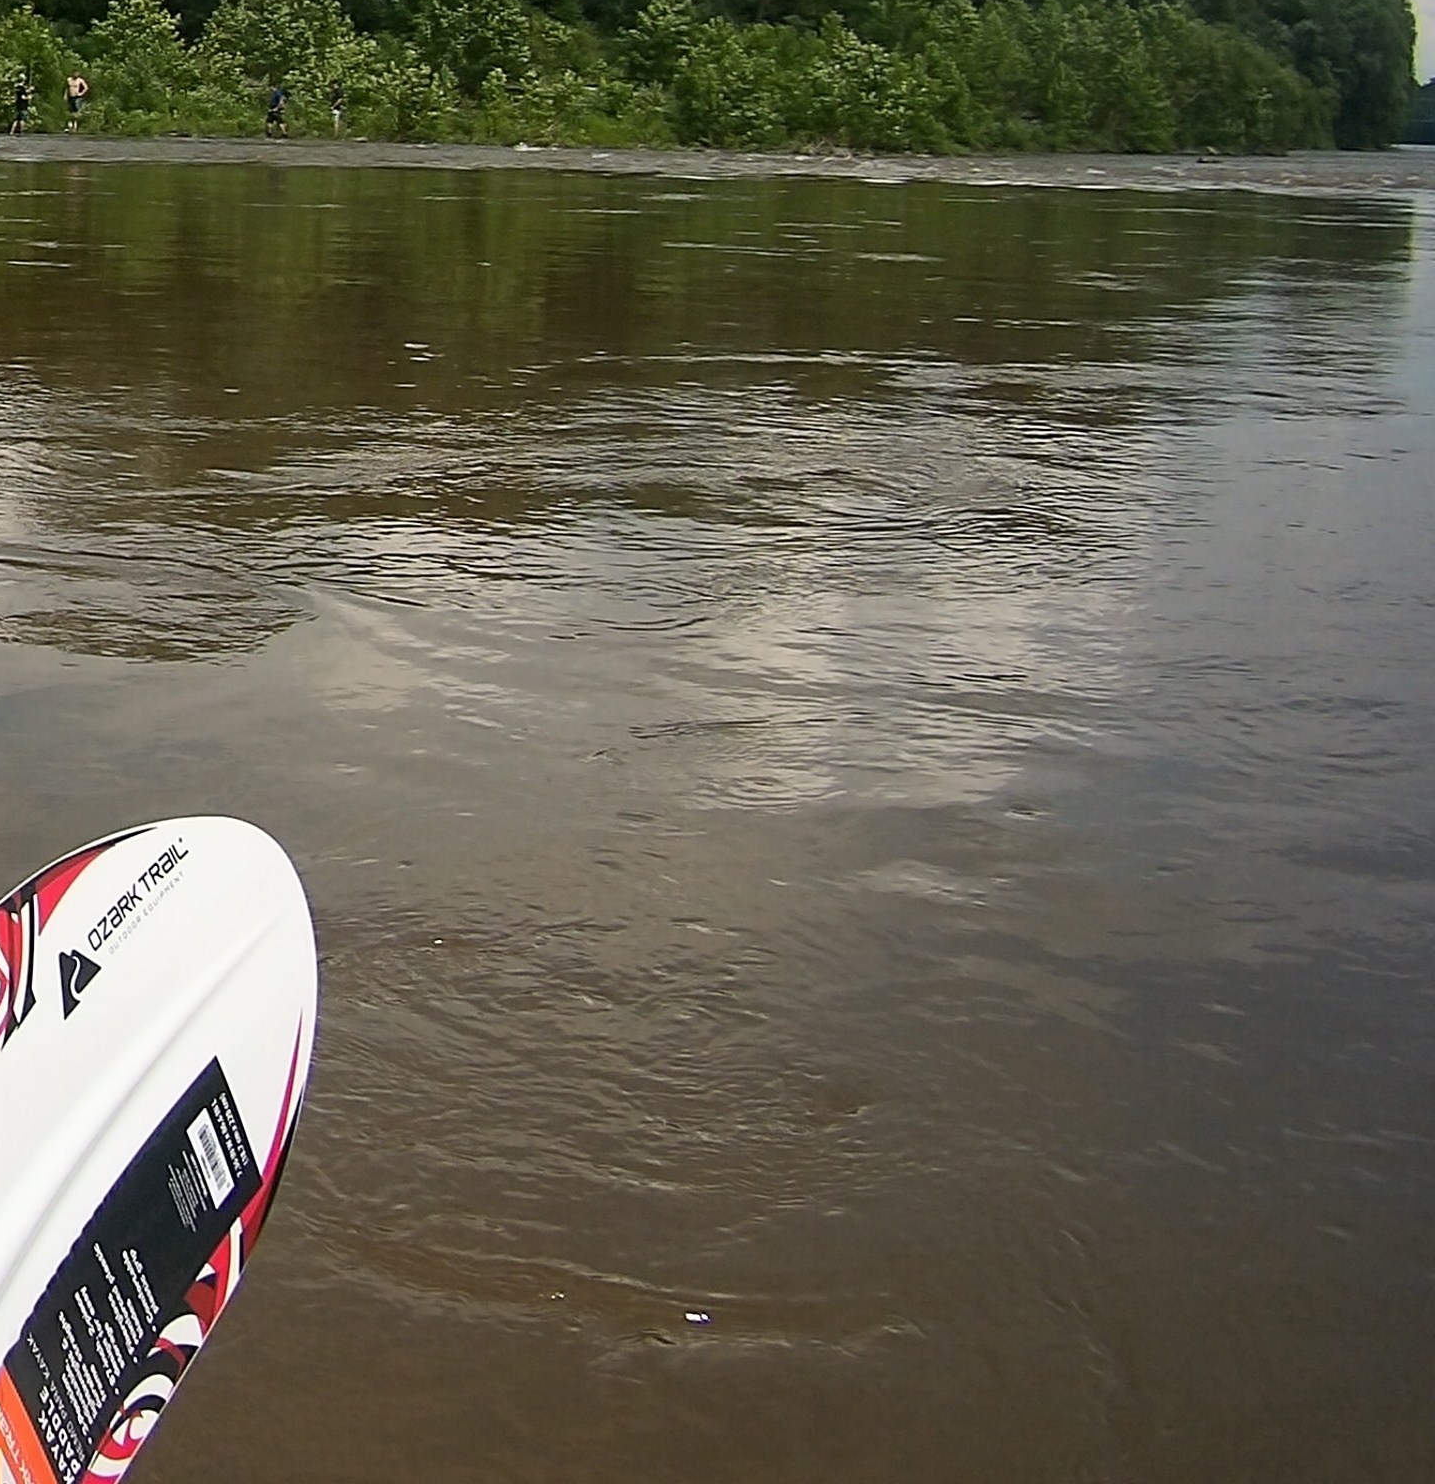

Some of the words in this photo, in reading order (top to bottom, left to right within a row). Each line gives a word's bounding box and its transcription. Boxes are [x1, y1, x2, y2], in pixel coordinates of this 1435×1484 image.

[108, 915, 141, 955] OUTDOOR
[143, 871, 183, 916] EQUIPMENT
[27, 1332, 50, 1380] KAYAK
[39, 1385, 81, 1474] PADDLE
[50, 1380, 68, 1419] PARA
[38, 1409, 74, 1484] KAYAK
[66, 1420, 85, 1462] REMO
